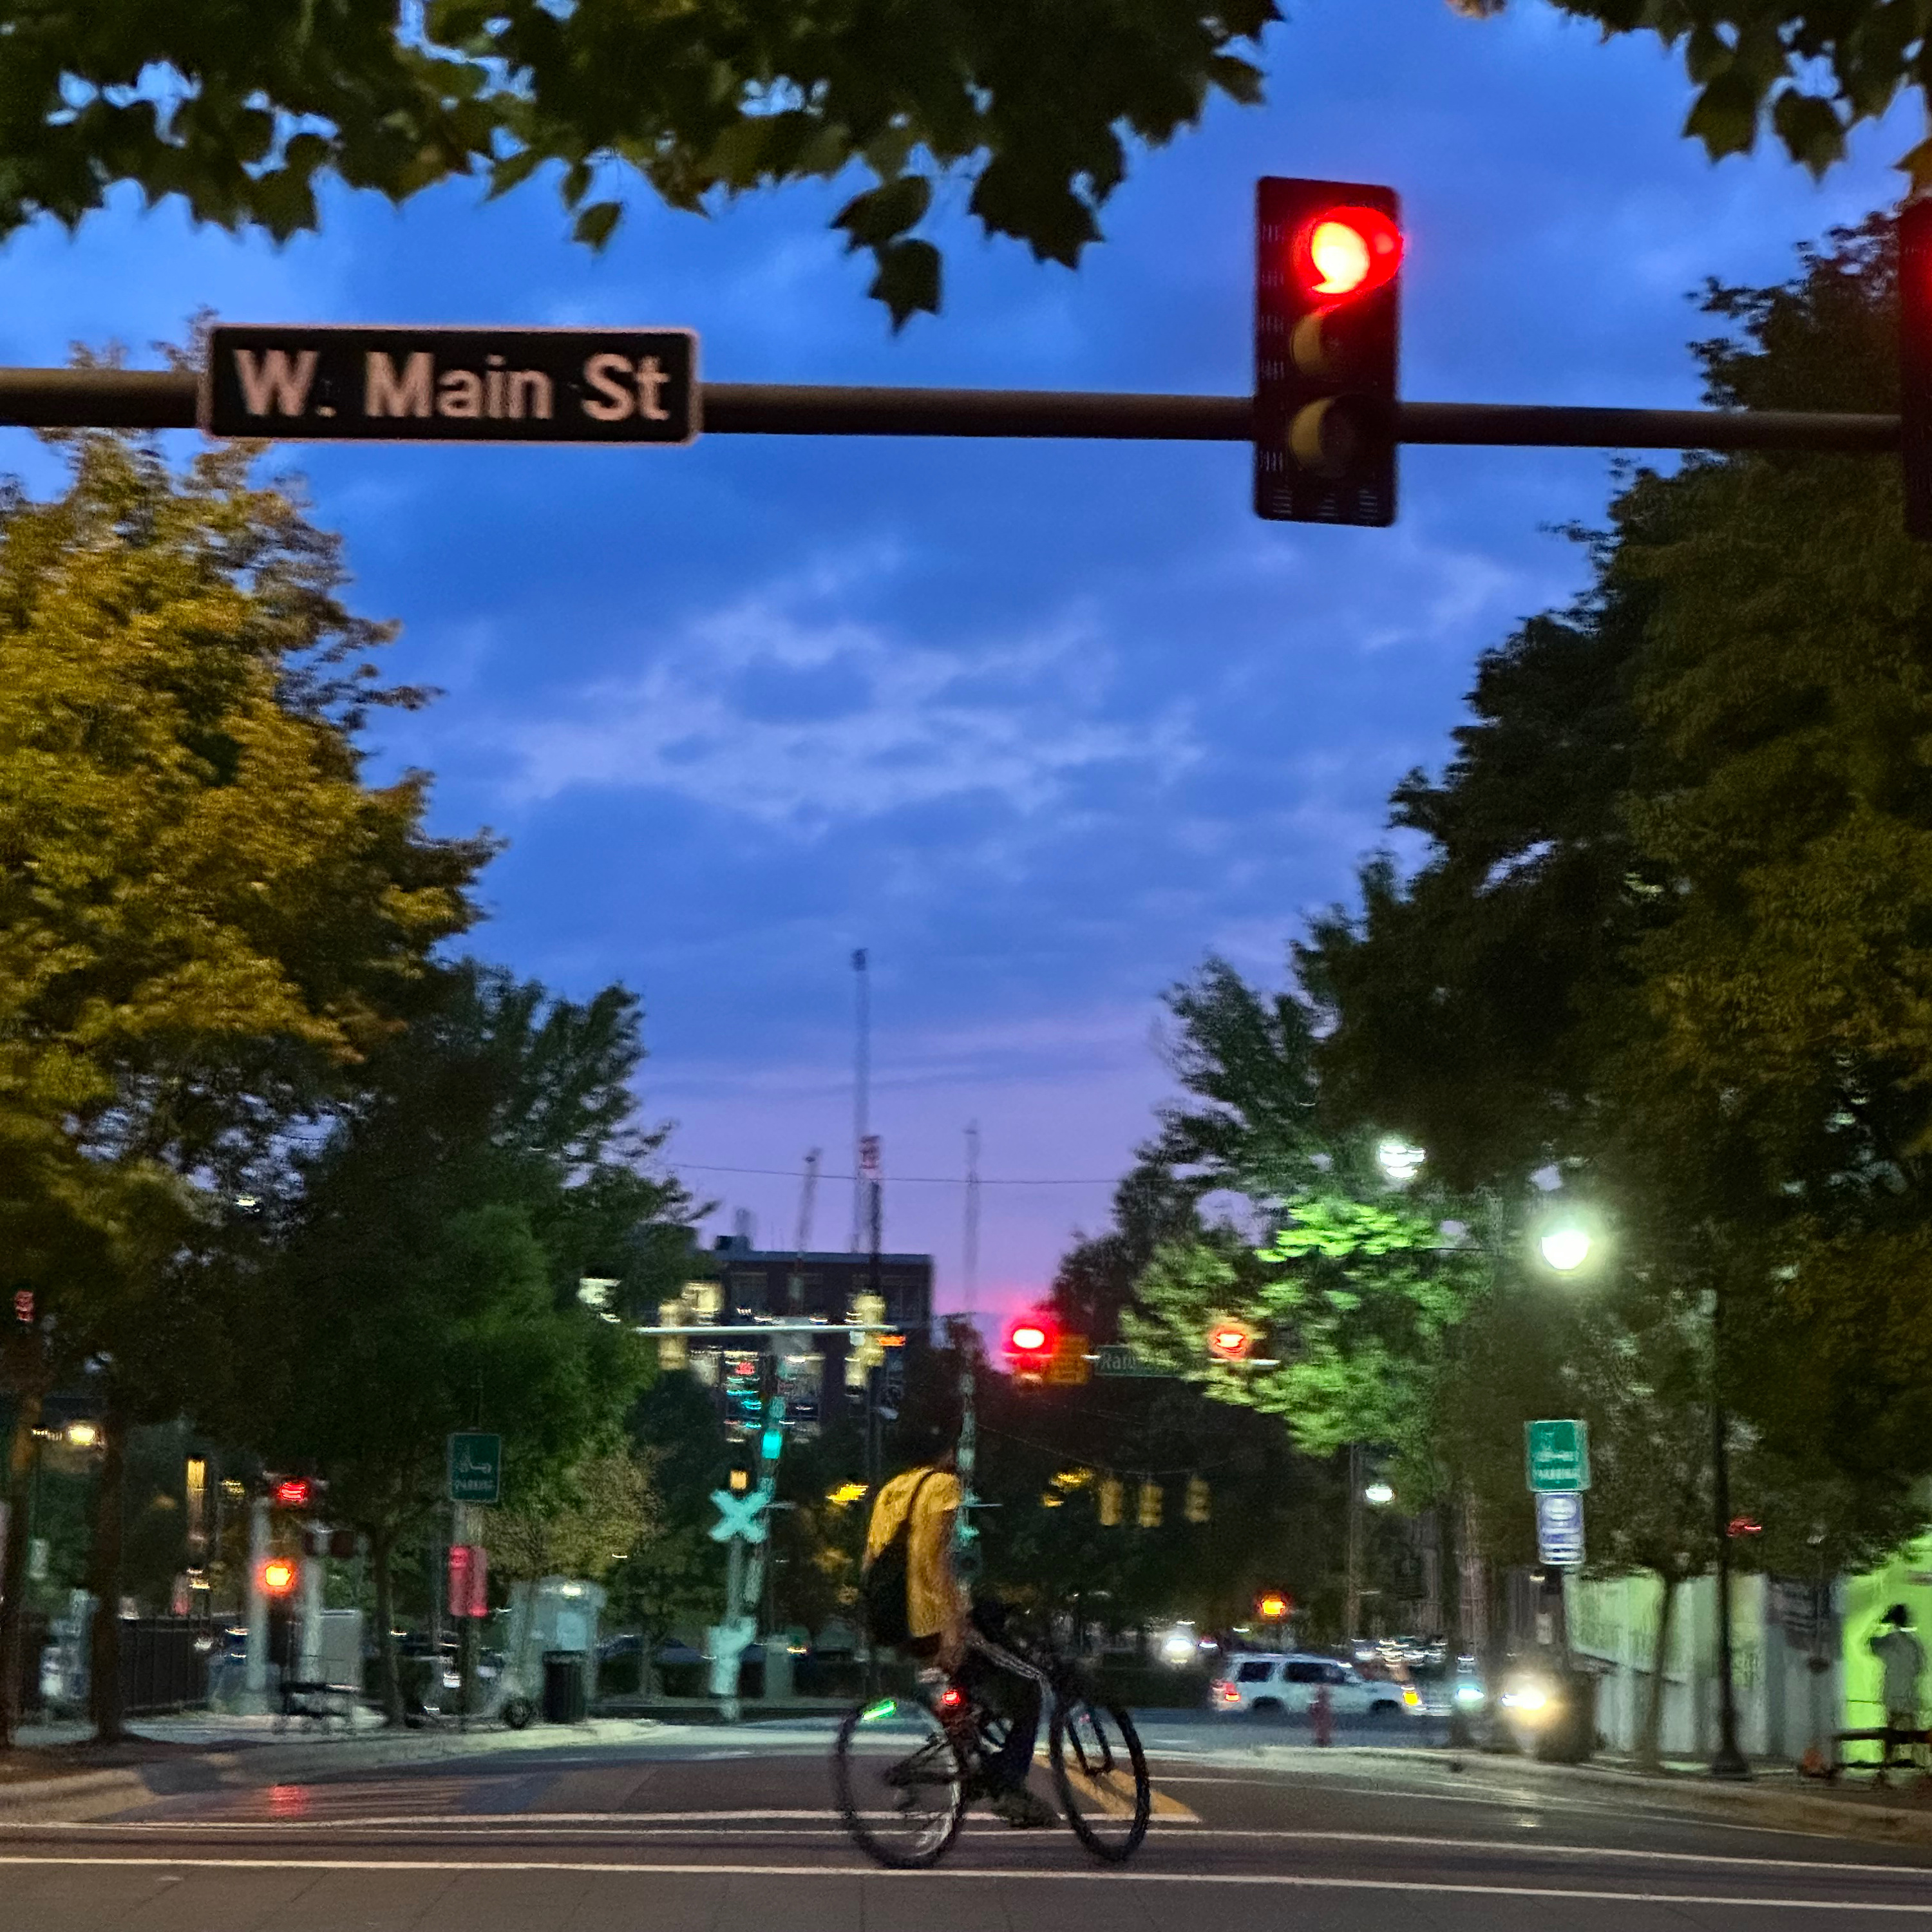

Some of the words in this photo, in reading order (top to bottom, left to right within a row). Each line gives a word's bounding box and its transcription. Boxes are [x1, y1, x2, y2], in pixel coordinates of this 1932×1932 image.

[232, 348, 337, 417] W.
[365, 351, 554, 420] Main
[582, 353, 670, 421] St
